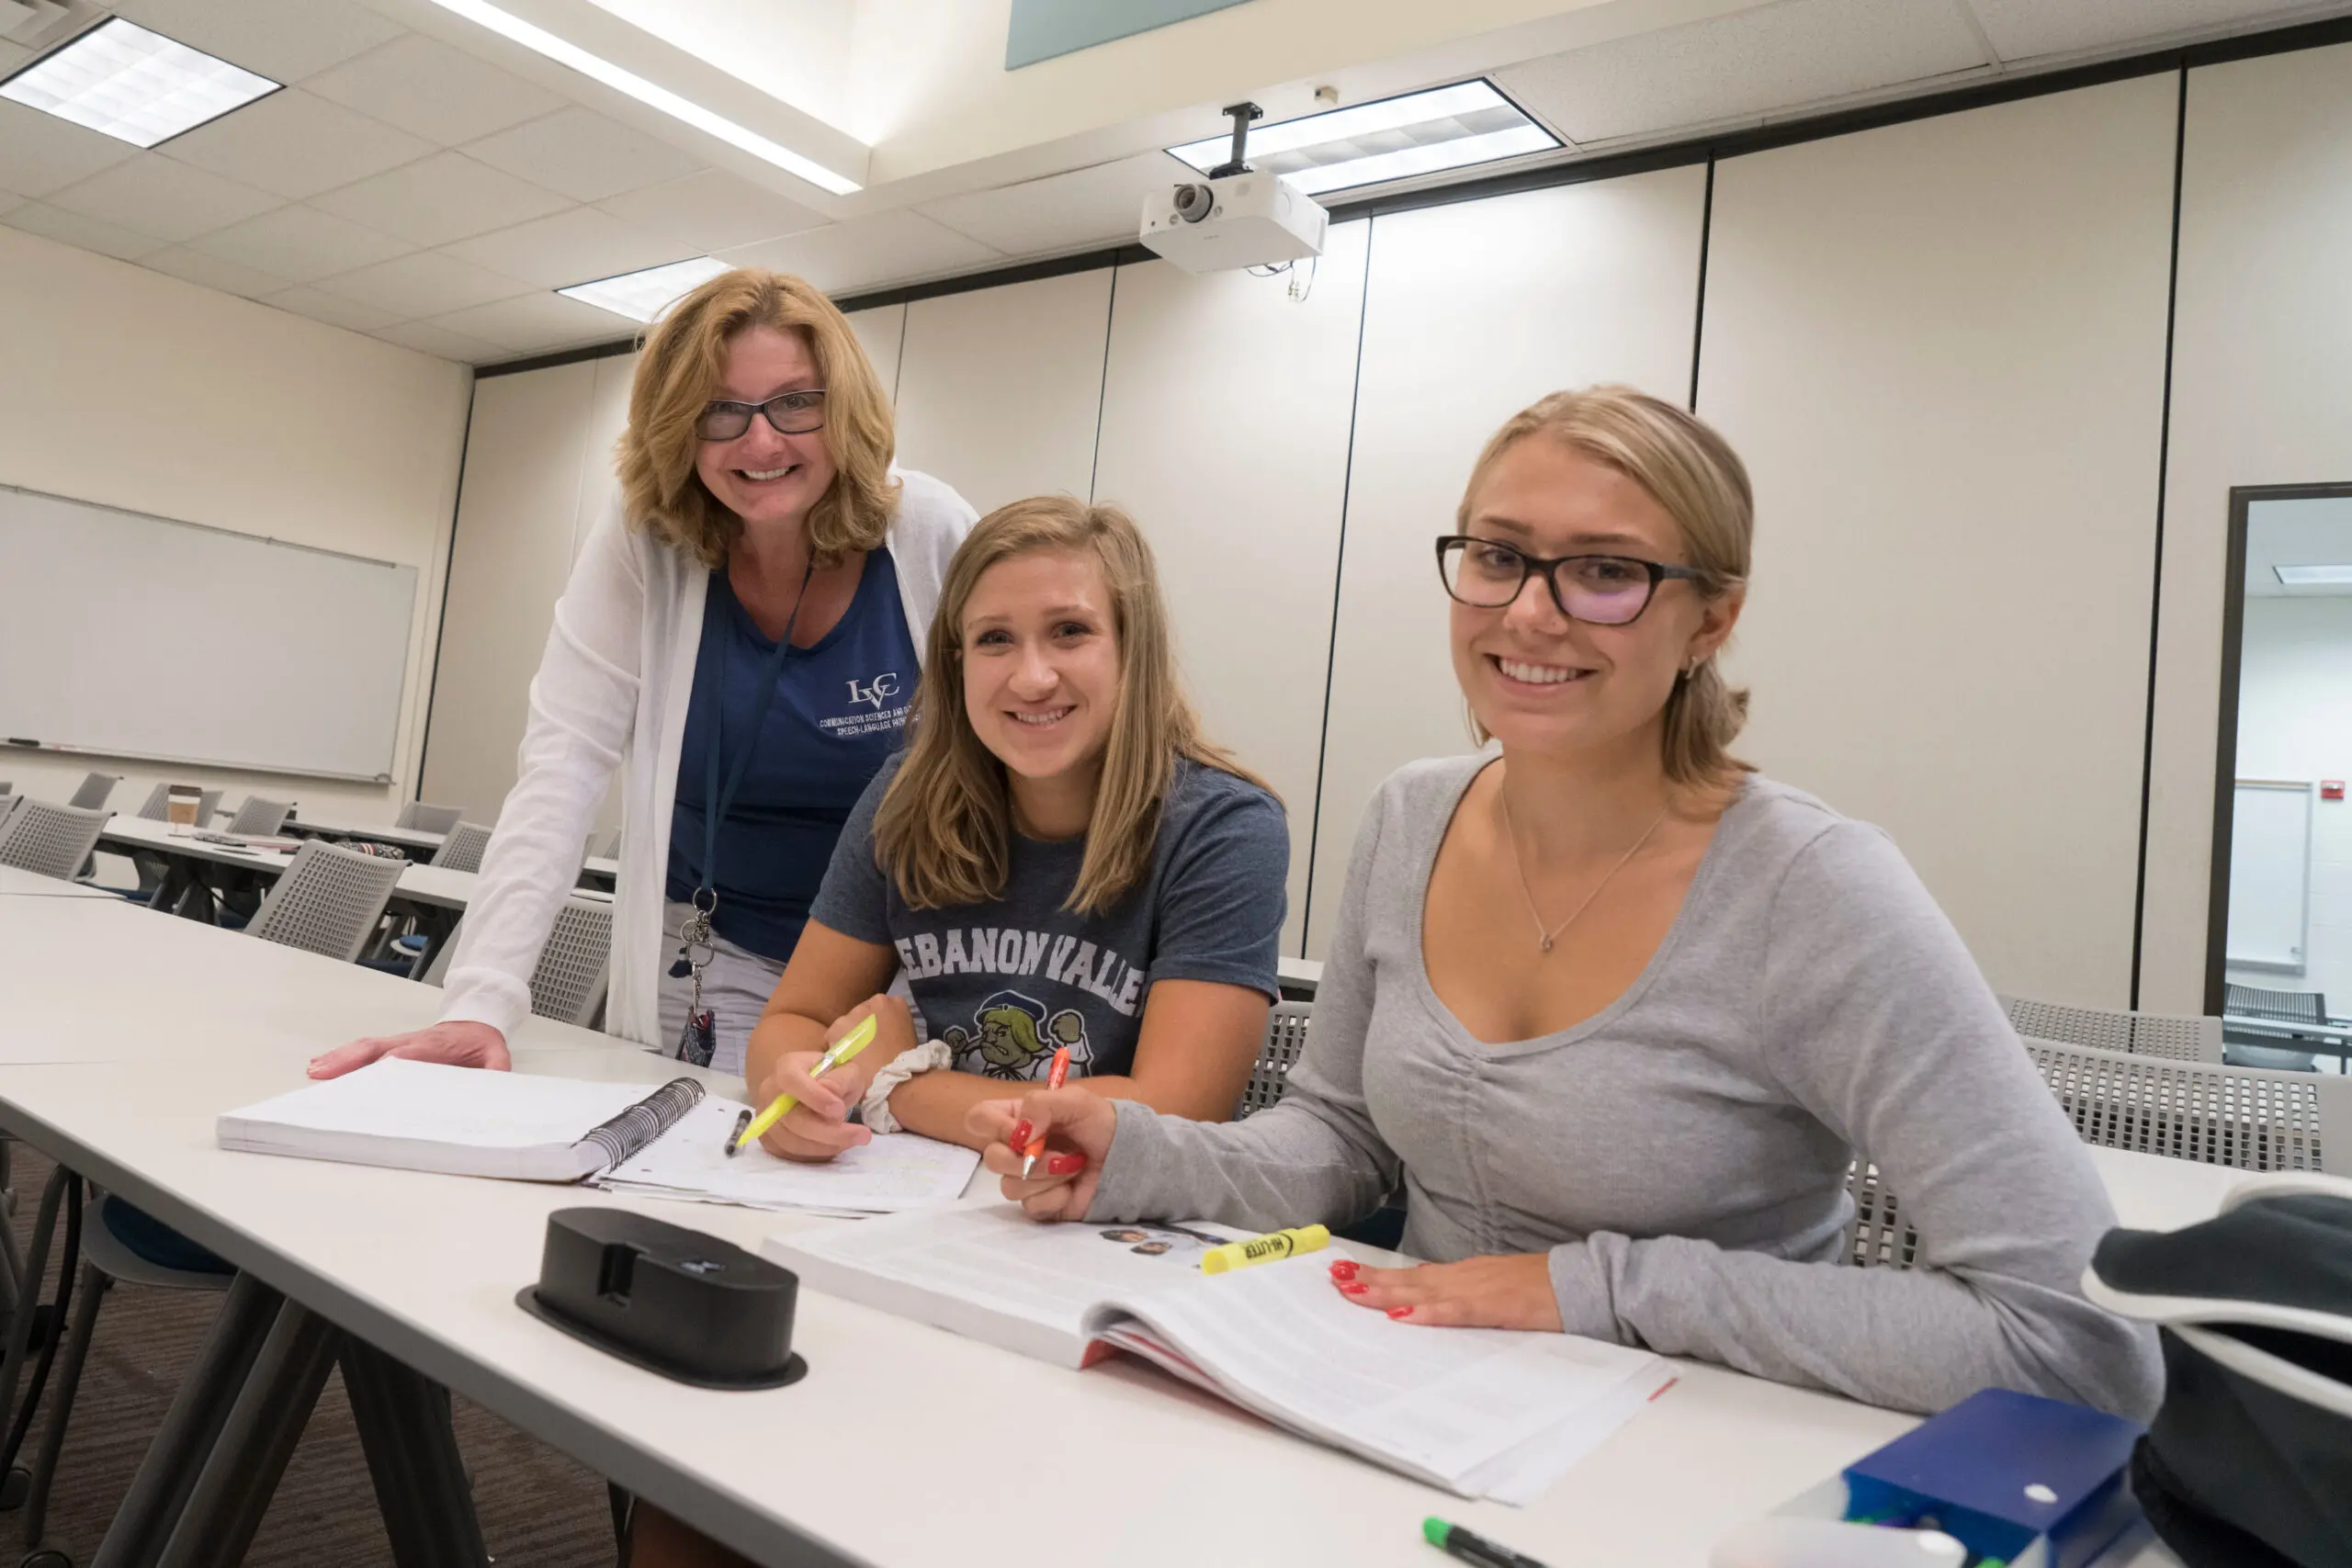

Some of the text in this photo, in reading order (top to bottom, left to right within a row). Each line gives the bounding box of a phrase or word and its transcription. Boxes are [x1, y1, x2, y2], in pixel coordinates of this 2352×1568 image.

[865, 710, 891, 722] SCIENCES
[837, 719, 892, 736] SPEECH-LANGUAGE
[895, 928, 1049, 980] EBANON
[1245, 1238, 1284, 1260] HI-LITER
